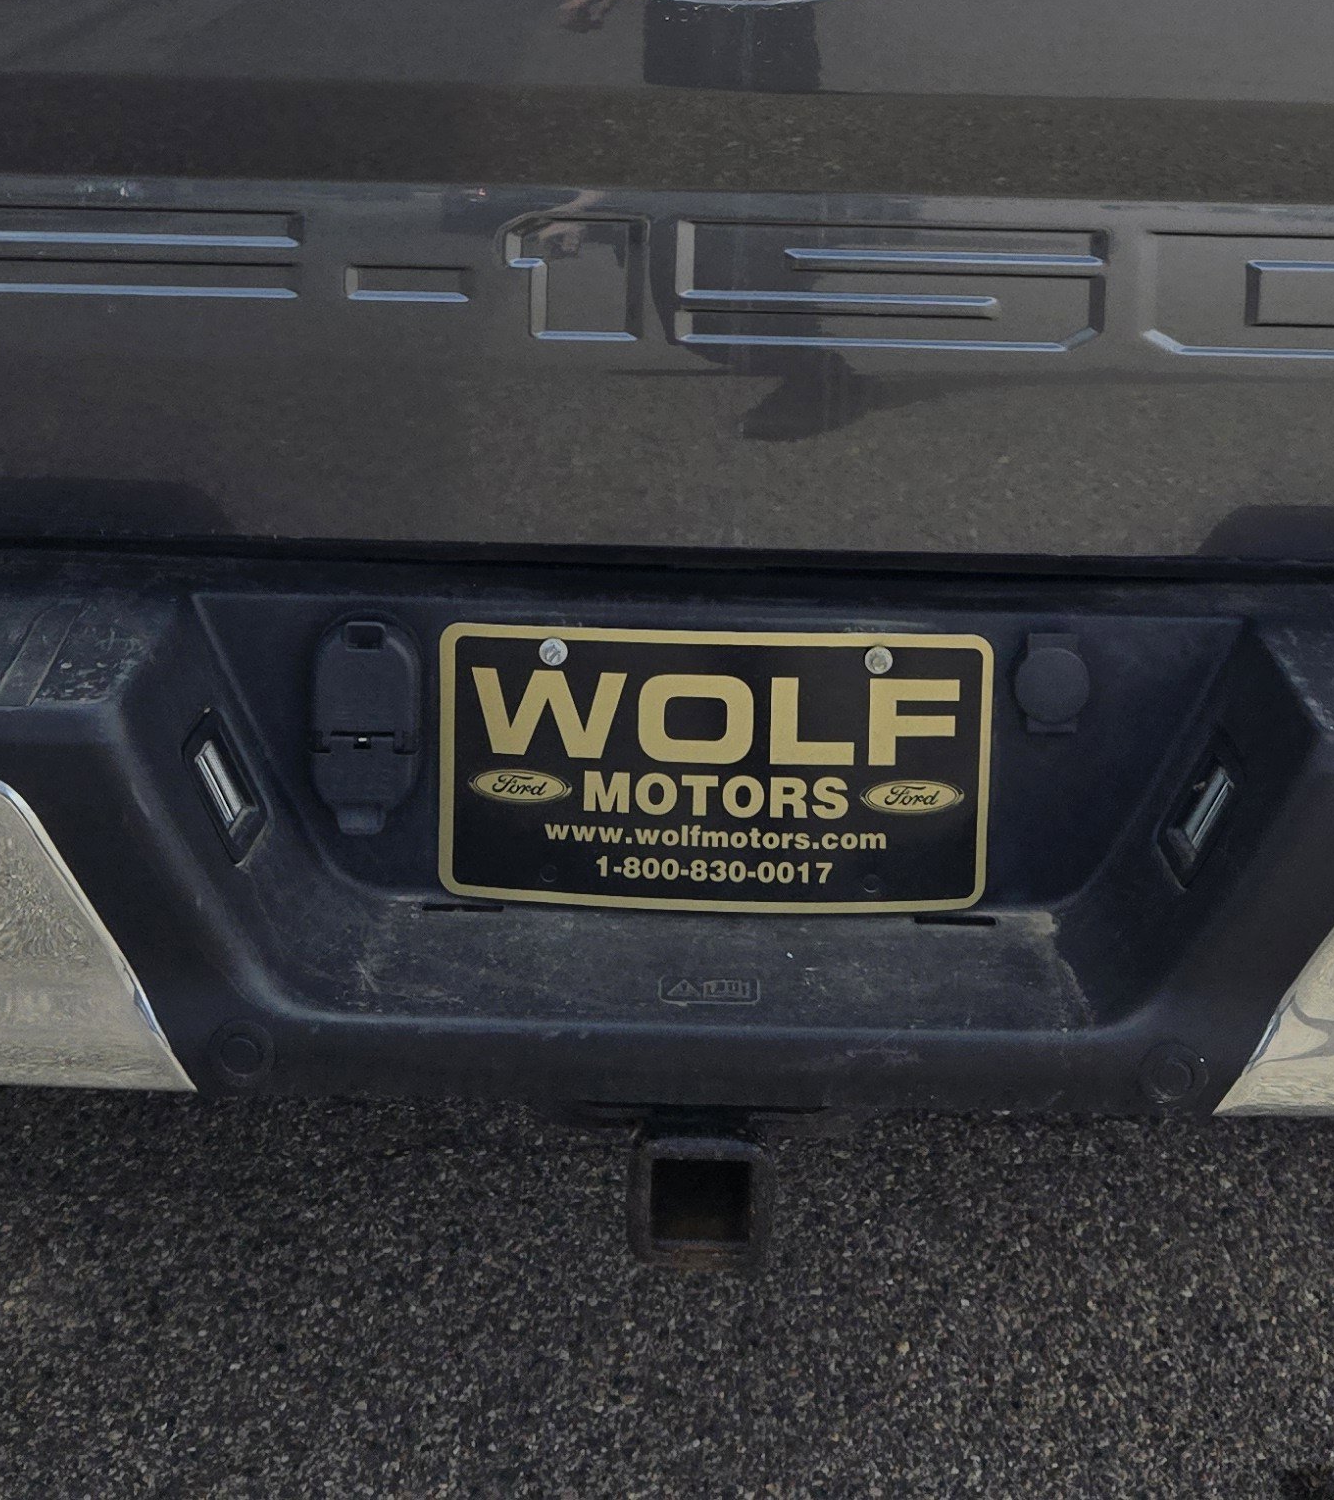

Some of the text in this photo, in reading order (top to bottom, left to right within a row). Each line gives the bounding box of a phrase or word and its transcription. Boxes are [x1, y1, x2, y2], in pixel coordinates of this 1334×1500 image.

[471, 665, 961, 766] WOLF
[491, 774, 547, 797] Ford
[582, 769, 850, 819] MOTORS
[883, 783, 940, 808] Ford
[544, 822, 887, 851] www.wolfmotors.com
[595, 855, 833, 885] 1-800-830-0017
